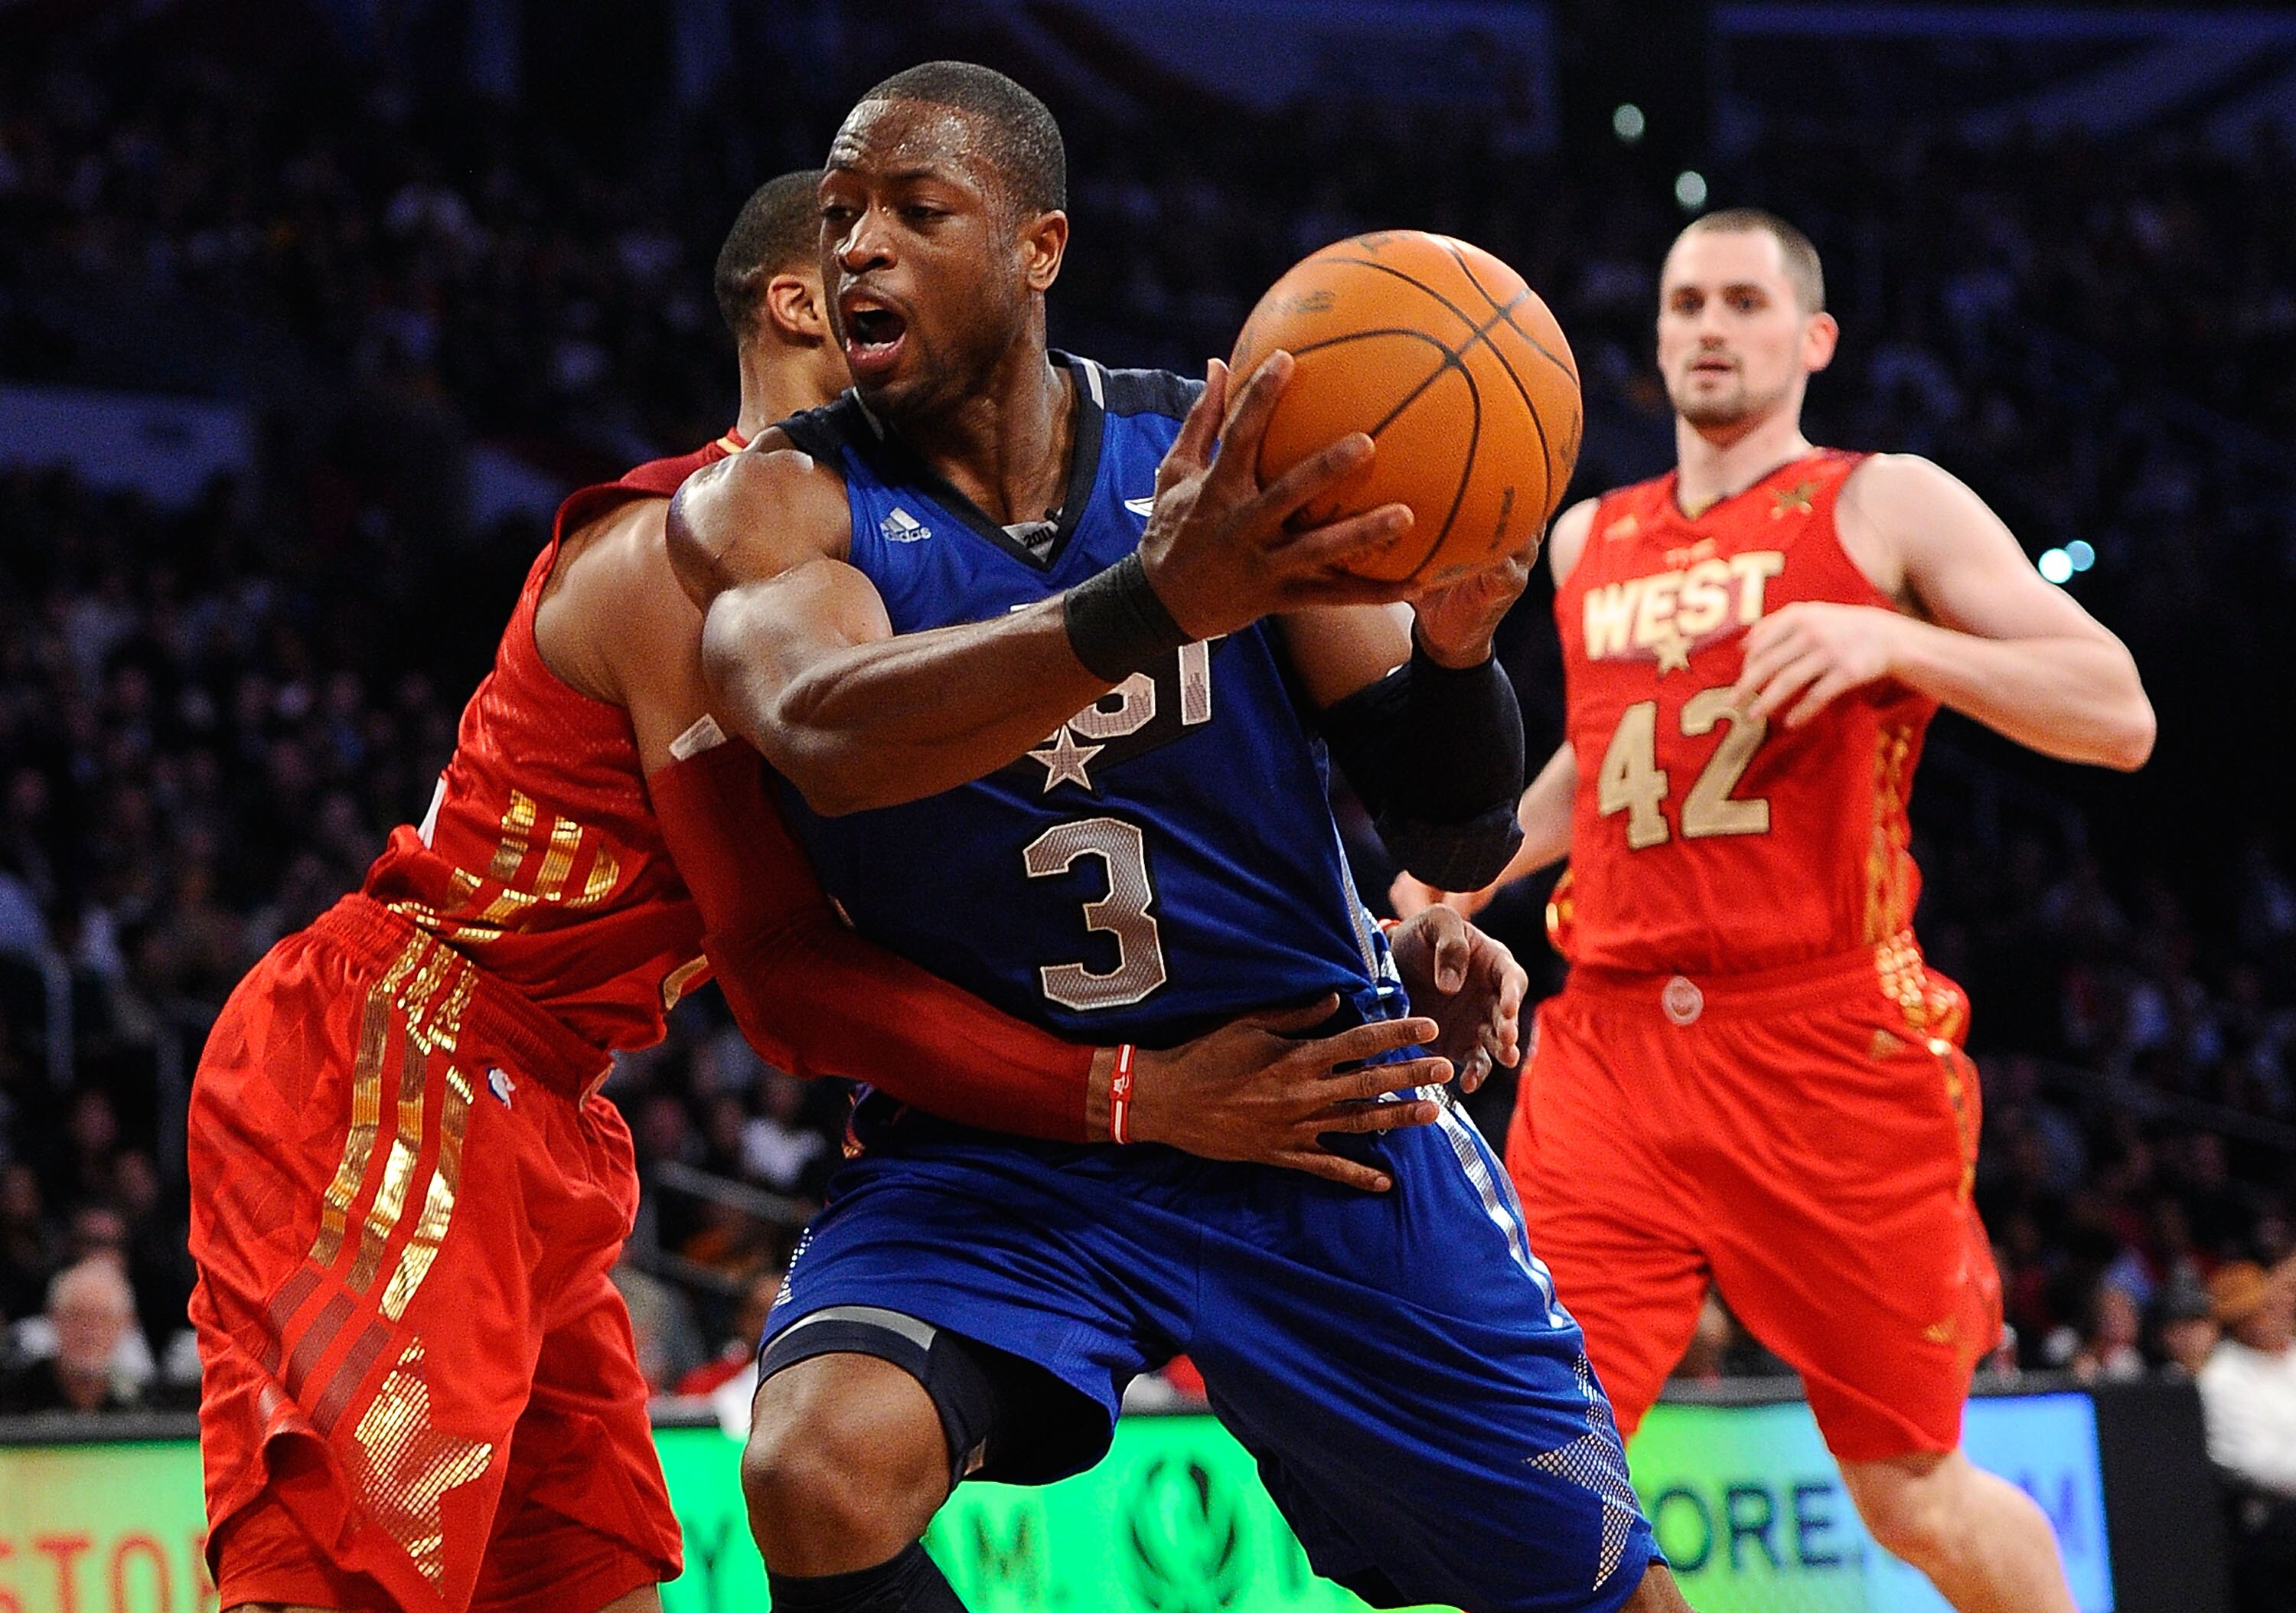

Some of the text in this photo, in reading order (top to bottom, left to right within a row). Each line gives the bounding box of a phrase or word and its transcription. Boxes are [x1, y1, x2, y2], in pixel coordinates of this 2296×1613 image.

[1581, 549, 1786, 662] WEST
[1597, 685, 1771, 851] 42
[1022, 816, 1168, 1012] 3
